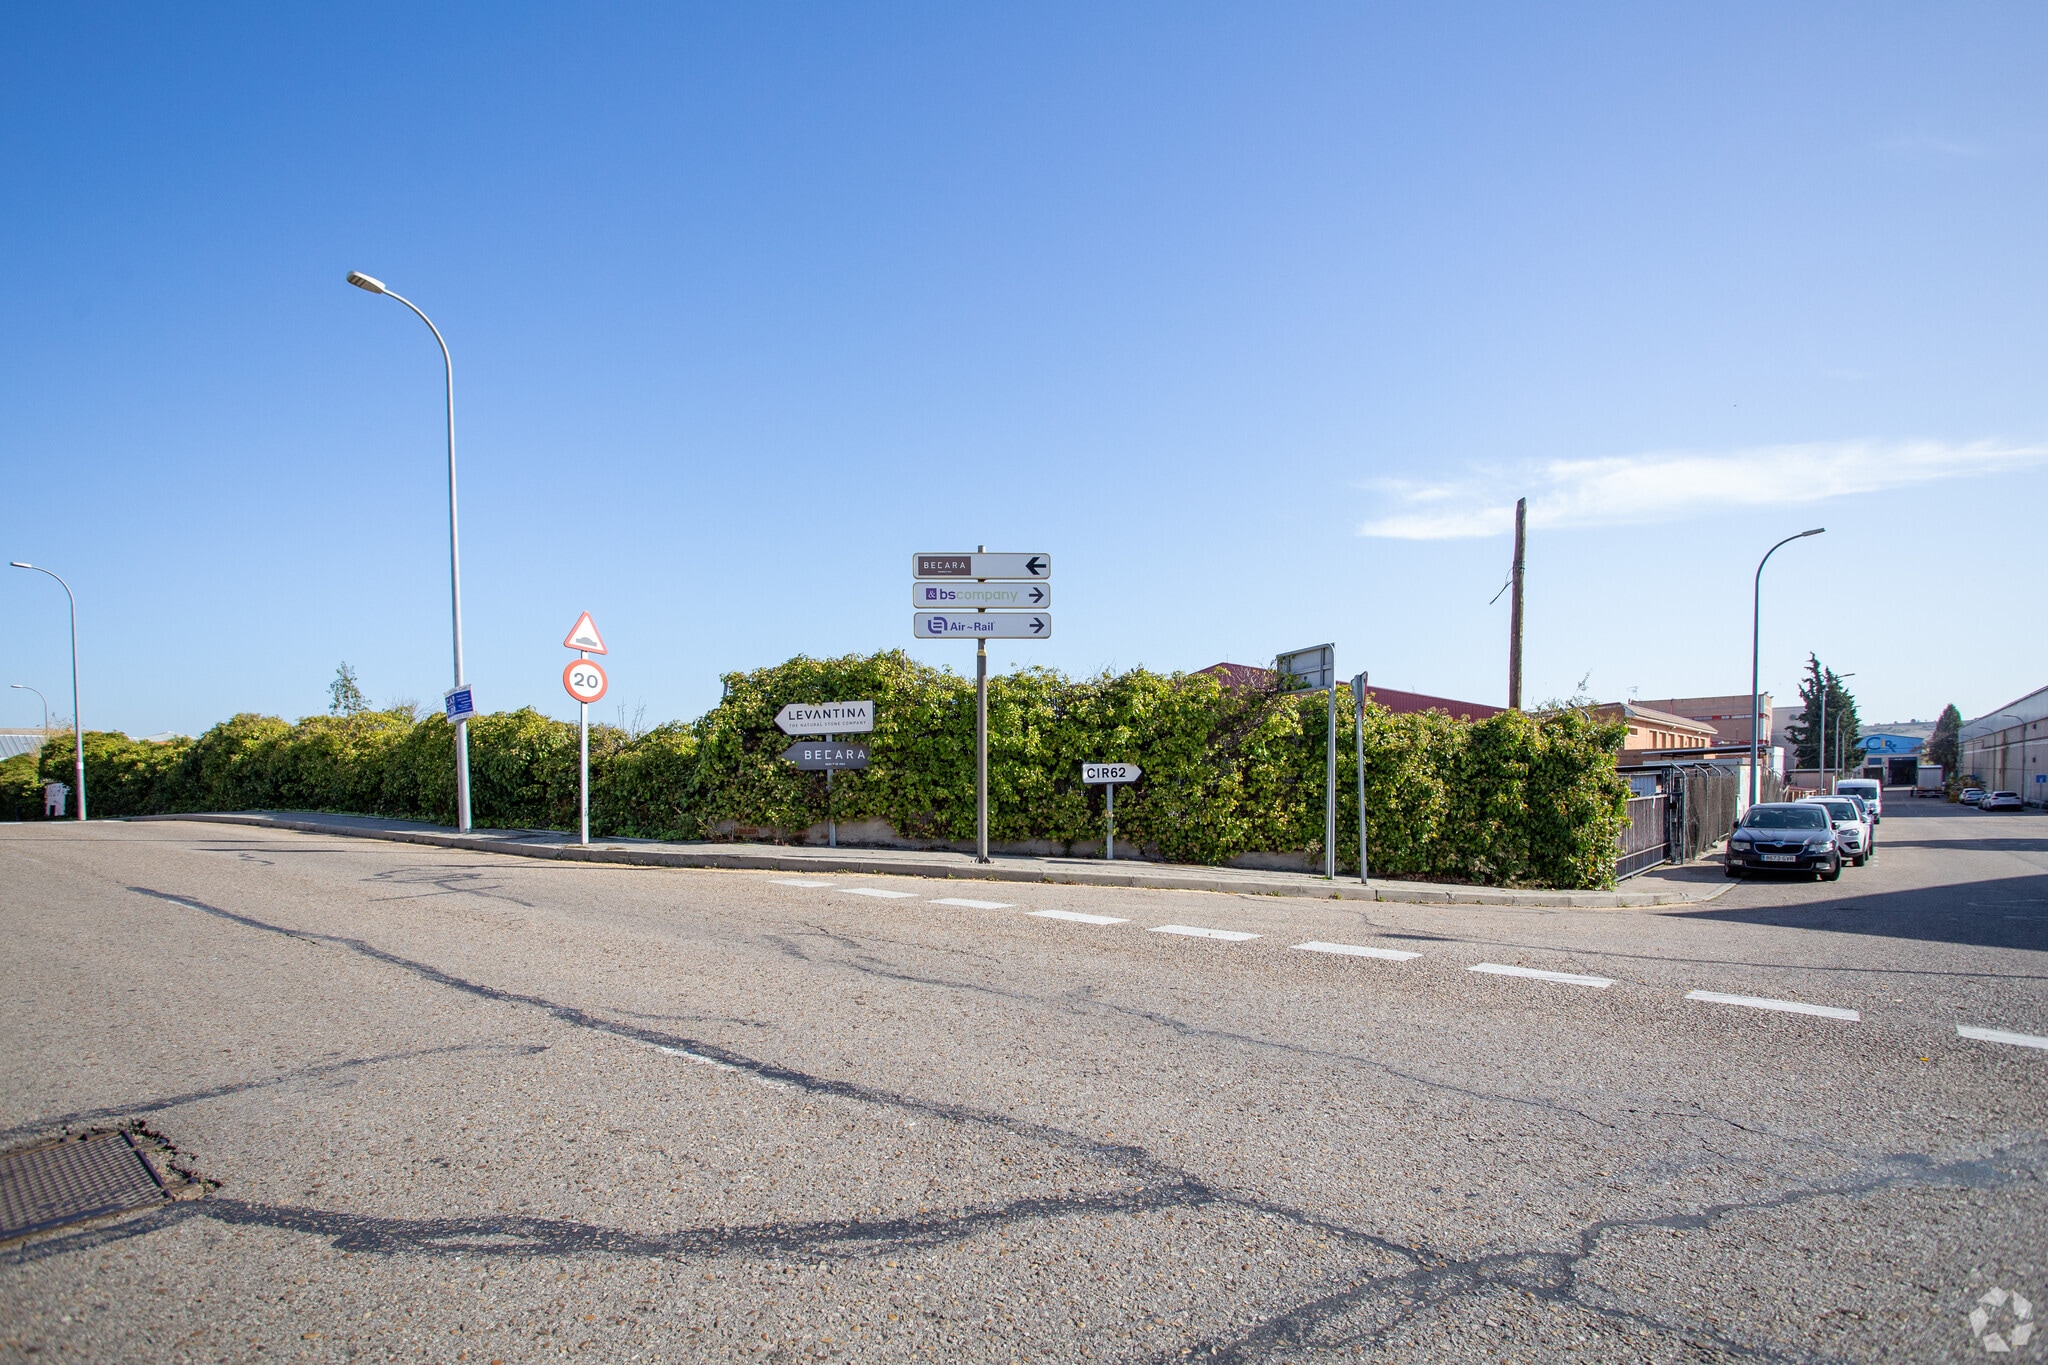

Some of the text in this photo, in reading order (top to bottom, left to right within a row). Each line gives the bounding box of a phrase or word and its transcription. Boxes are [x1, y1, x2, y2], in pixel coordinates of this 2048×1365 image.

[923, 561, 966, 569] BECARA
[940, 588, 1018, 602] bscompany
[574, 672, 599, 689] 20
[788, 708, 866, 721] LEVANTINA
[804, 749, 866, 760] BECARA
[1086, 767, 1126, 778] CIR62
